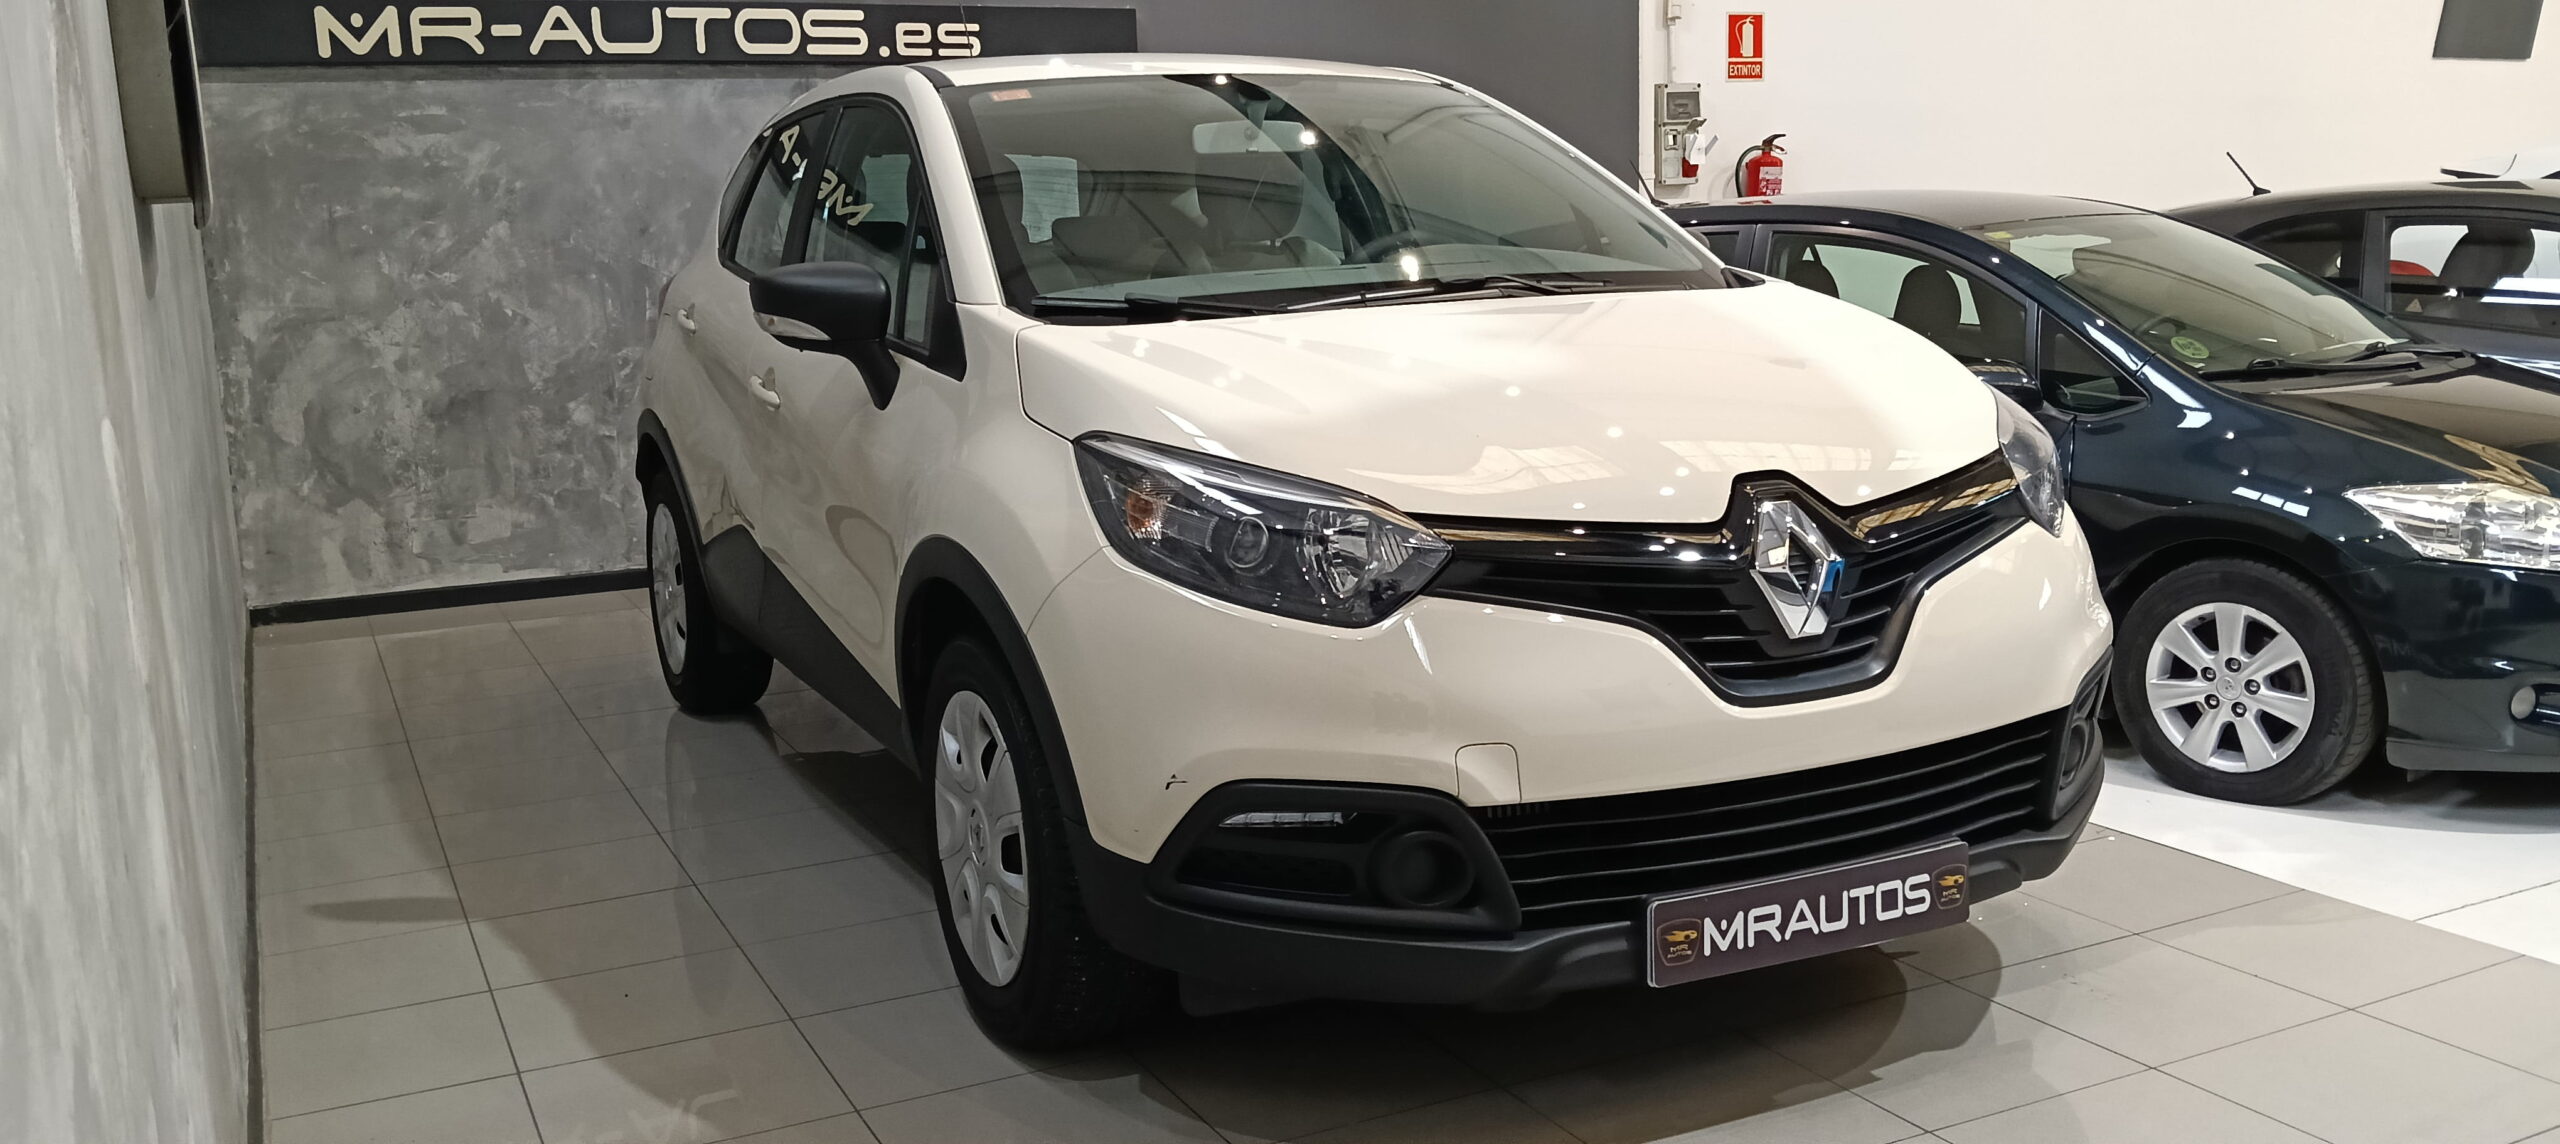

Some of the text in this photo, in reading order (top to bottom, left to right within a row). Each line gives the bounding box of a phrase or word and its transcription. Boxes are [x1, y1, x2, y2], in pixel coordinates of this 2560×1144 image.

[313, 5, 982, 59] MR-AUTOS.es
[1729, 64, 1761, 76] EXTINTOR
[1703, 873, 1931, 957] MRAUTOS
